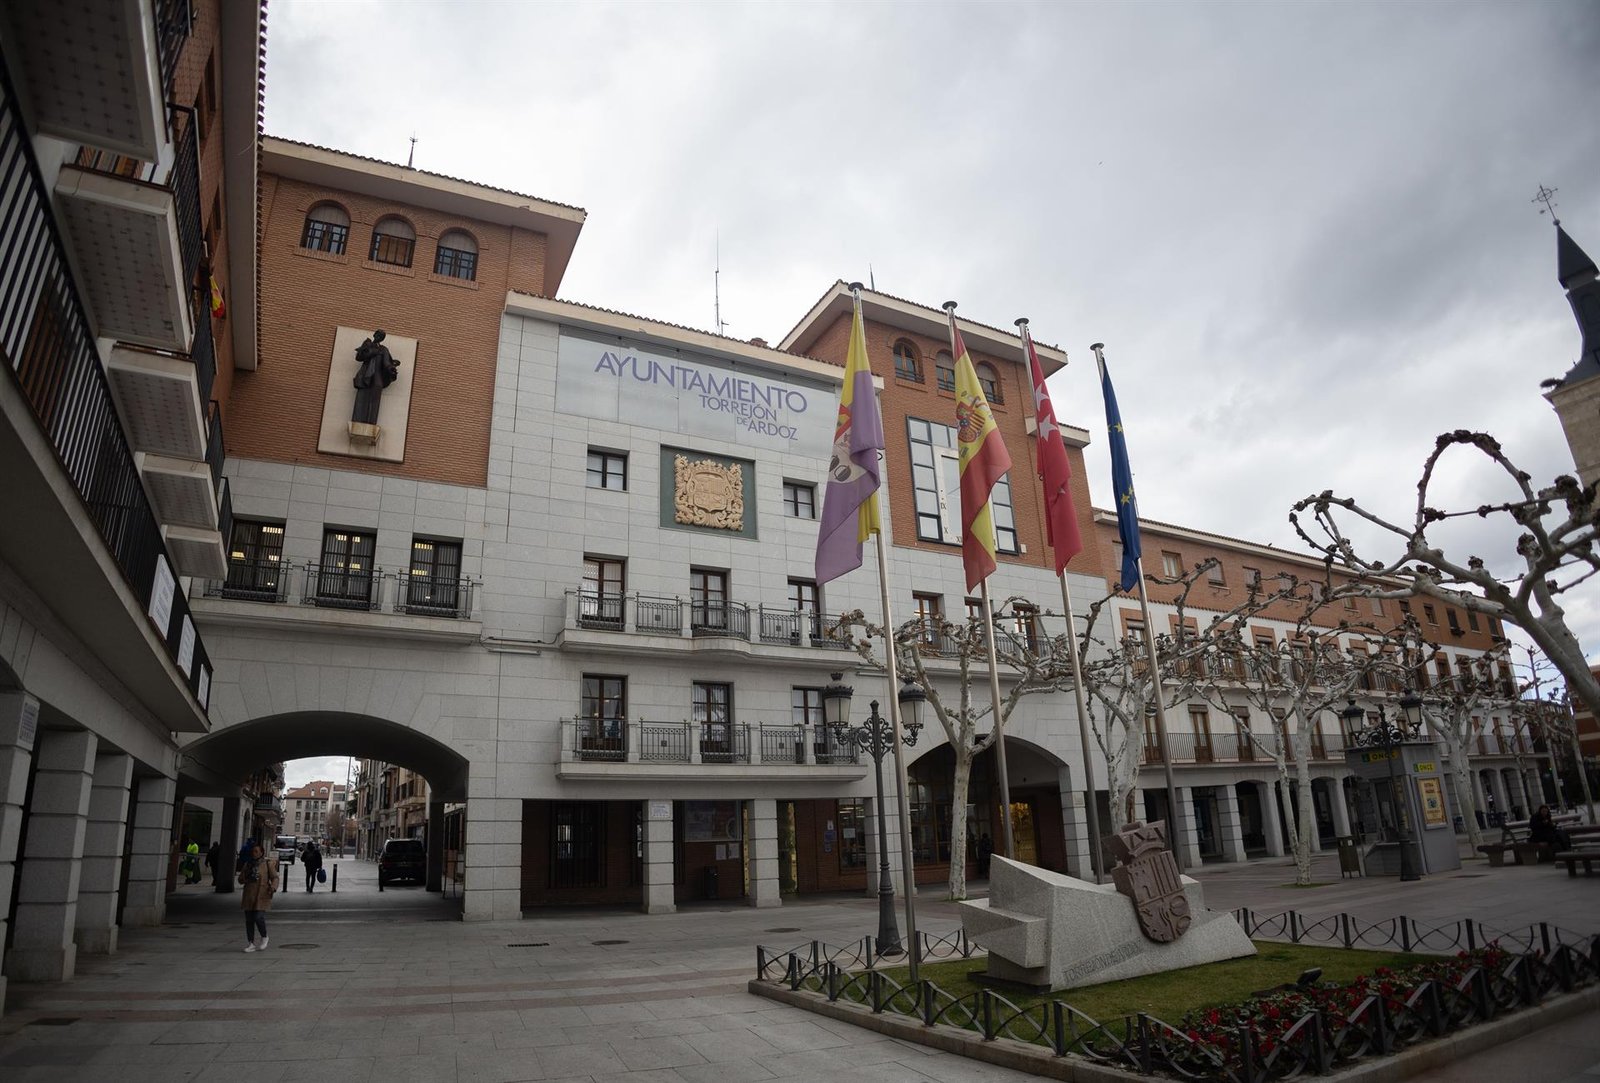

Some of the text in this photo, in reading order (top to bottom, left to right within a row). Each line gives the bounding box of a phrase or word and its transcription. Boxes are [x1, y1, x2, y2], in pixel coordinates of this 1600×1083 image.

[594, 351, 808, 413] AYUNTAMIENTO
[698, 394, 777, 422] TORREJÓN
[736, 416, 798, 441] DE ARDOZ
